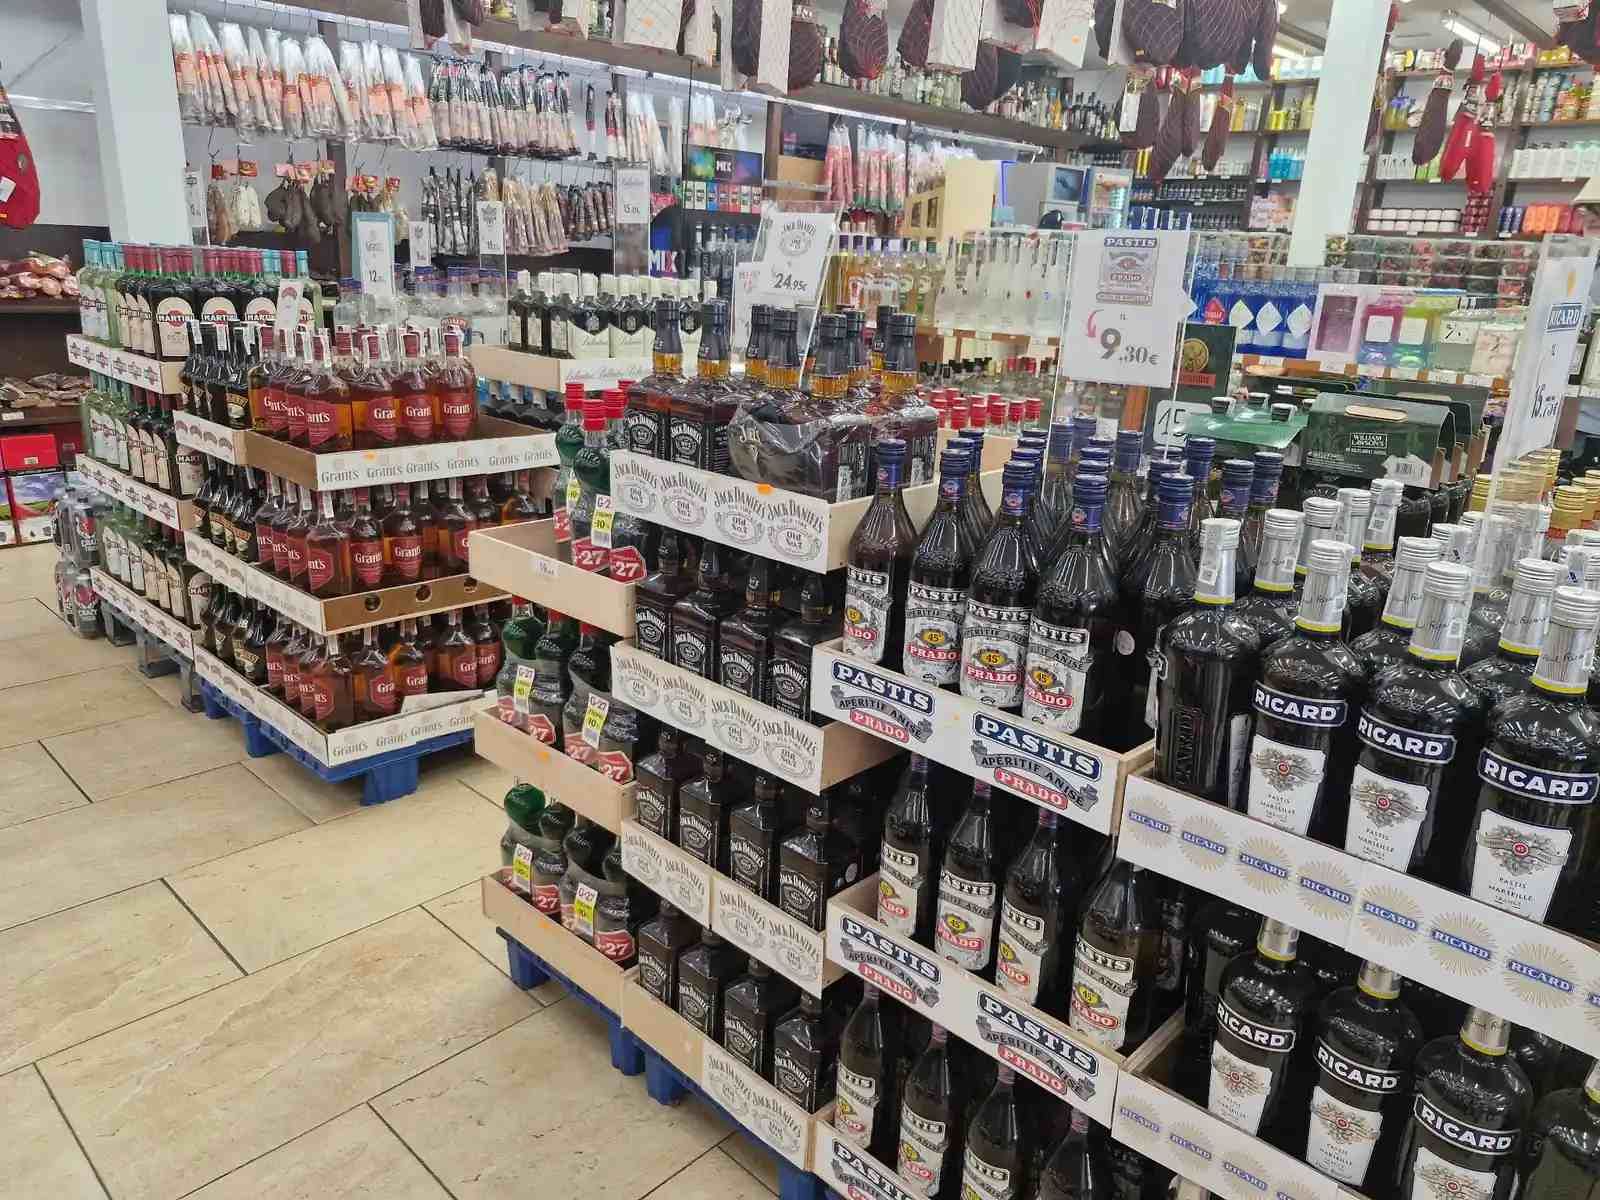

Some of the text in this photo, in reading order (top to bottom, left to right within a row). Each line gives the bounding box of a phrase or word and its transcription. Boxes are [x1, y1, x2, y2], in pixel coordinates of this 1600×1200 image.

[1105, 238, 1156, 248] PASTIS
[615, 462, 631, 479] JACK
[660, 476, 676, 492] JACK
[714, 489, 733, 506] JACK
[767, 503, 787, 520] JACK
[968, 602, 1029, 621] PASTIS
[772, 662, 786, 676] JACK
[967, 664, 1018, 682] PRADO
[837, 663, 931, 712] PASTIS
[711, 699, 728, 714] JACK
[1255, 688, 1338, 722] RICARD
[762, 720, 780, 736] JACK
[854, 711, 907, 740] PRADO
[1359, 715, 1445, 758] RICARD
[979, 717, 1096, 775] PASTIS
[981, 756, 1041, 772] APERITIF
[1484, 757, 1589, 798] RICARD
[999, 770, 1064, 806] PRADO
[1130, 810, 1170, 833] RICARD
[1182, 832, 1227, 855] RICARD
[1240, 855, 1288, 879] RICARD
[1302, 878, 1351, 903] RICARD
[1365, 903, 1417, 930] RICARD
[846, 920, 940, 981] PASTIS
[1432, 931, 1491, 960] RICARD
[863, 964, 913, 1000] PRADO
[1511, 961, 1572, 991] RICARD
[985, 995, 1097, 1072] PASTIS
[1217, 1002, 1287, 1048] RICARD
[1000, 1046, 1064, 1091] PRADO
[1318, 1045, 1399, 1090] RICARD
[1420, 1108, 1514, 1152] RICARD
